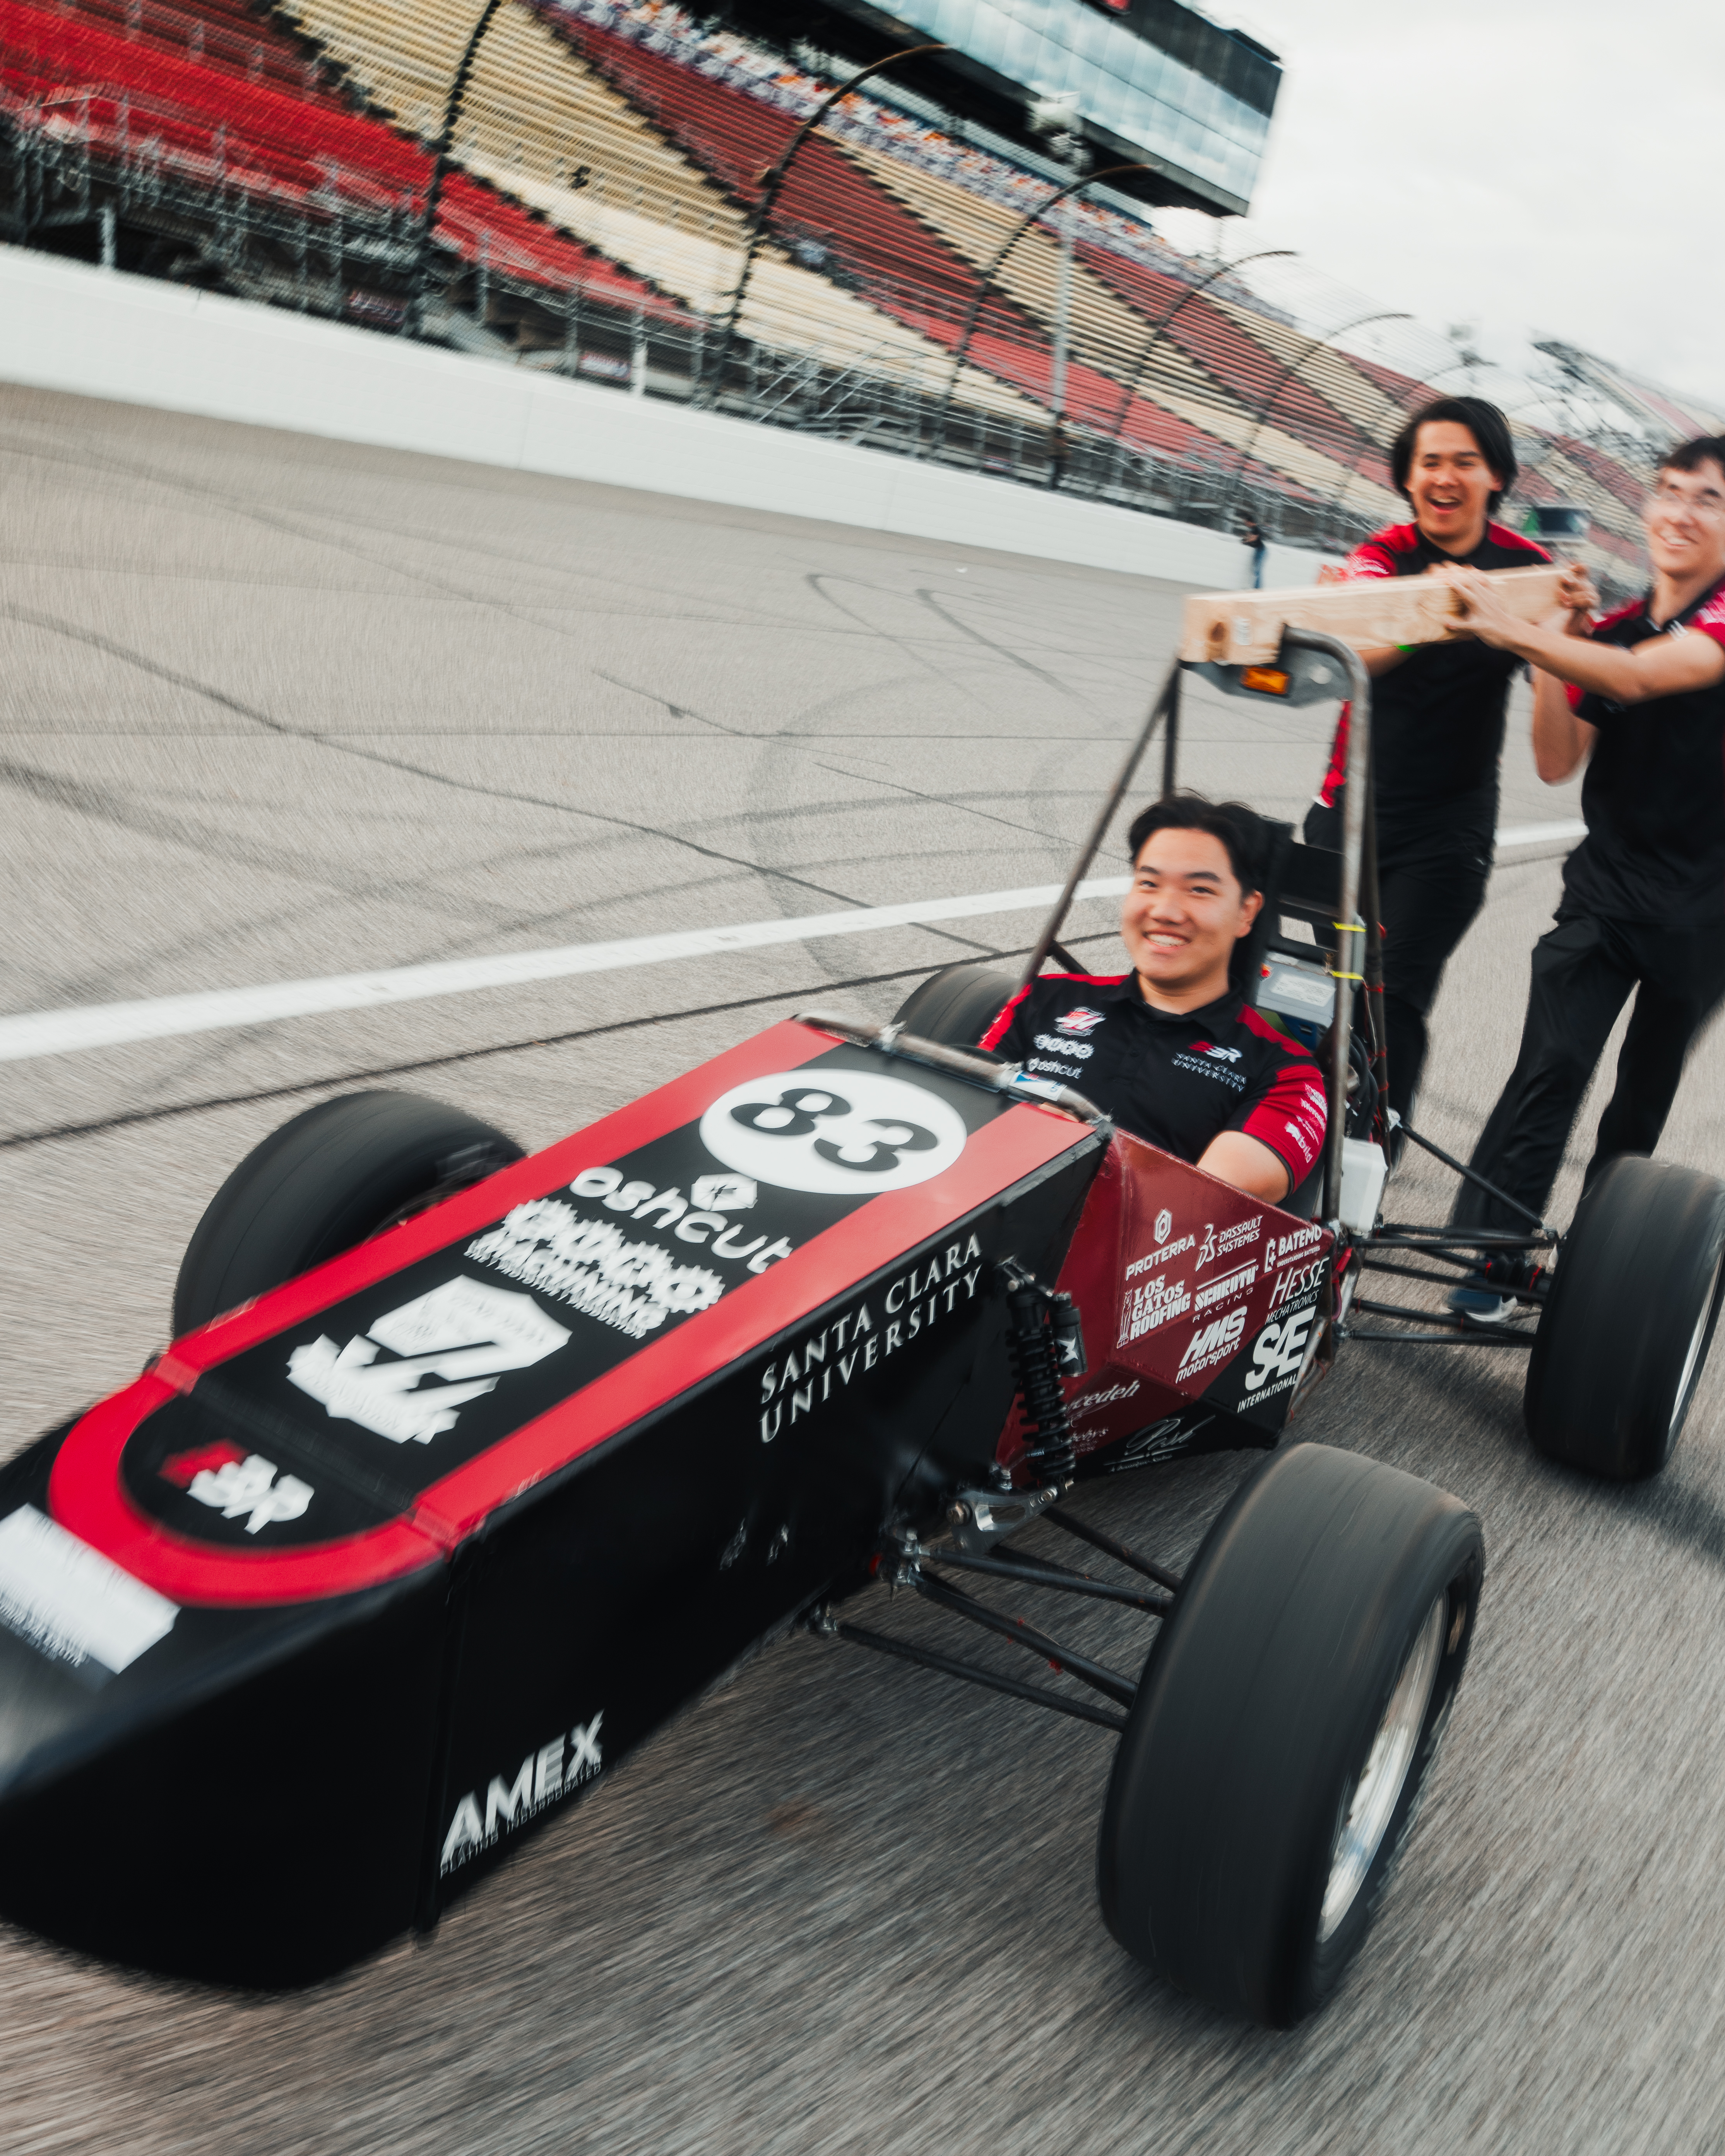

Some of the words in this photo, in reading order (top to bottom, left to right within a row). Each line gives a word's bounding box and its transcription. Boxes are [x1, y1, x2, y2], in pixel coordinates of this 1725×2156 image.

[1171, 1057, 1245, 1092] UNIVERSITY
[730, 1088, 938, 1171] 83
[1217, 1229, 1260, 1257] SYSTEMES
[1219, 1215, 1263, 1243] DASSAULT
[1278, 1225, 1322, 1257] BATEMO
[1126, 1233, 1196, 1281] PROTERRA
[1277, 1252, 1304, 1268] UNDERSTANDING
[1304, 1245, 1321, 1257] BATTERIES
[1131, 1279, 1185, 1322] GATOS
[1133, 1274, 1166, 1306] LOS
[1192, 1287, 1254, 1323] RACING
[1268, 1257, 1330, 1310] HESSE
[760, 1302, 874, 1405] SANTA
[885, 1232, 983, 1314] CLARA
[1130, 1292, 1192, 1341] ROOFING
[1265, 1289, 1319, 1325] MECHATRONICS
[759, 1264, 983, 1443] UNIVERSITY
[1179, 1305, 1248, 1369] HMS
[1245, 1305, 1316, 1391] SAE
[1175, 1336, 1241, 1384] motorsport
[1237, 1373, 1297, 1414] INTERNATIONAL
[440, 1708, 605, 1865] AMEX
